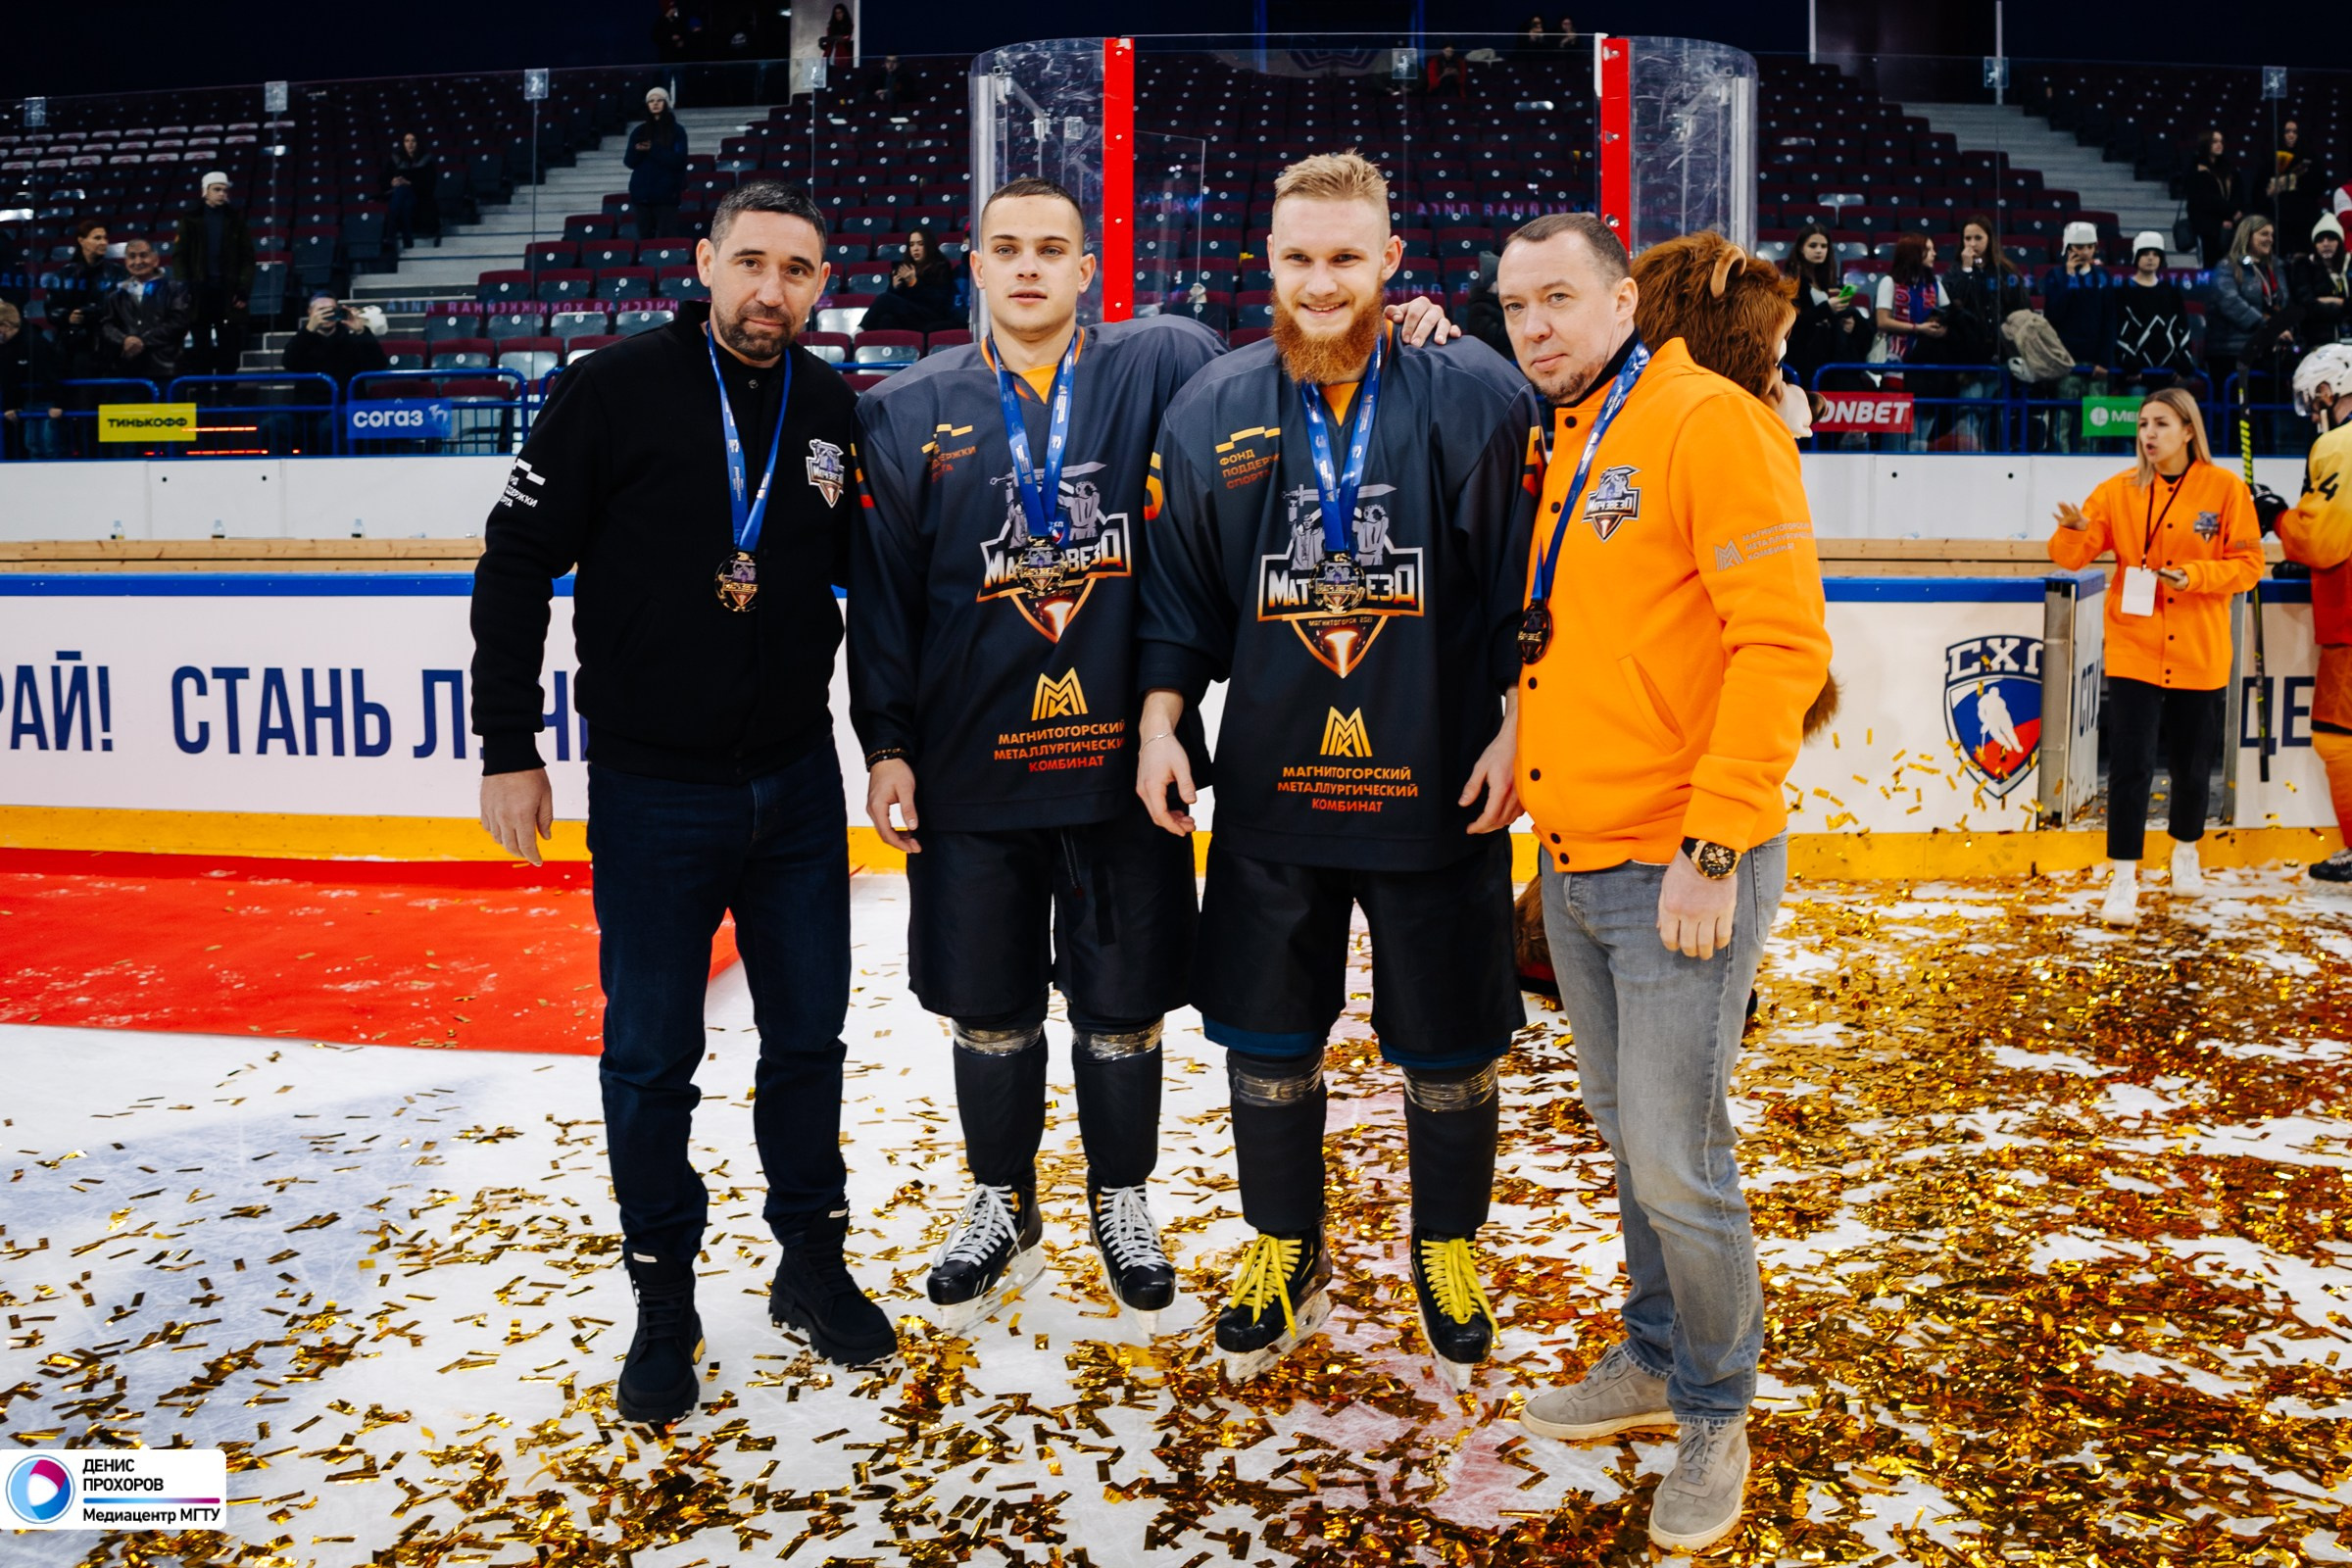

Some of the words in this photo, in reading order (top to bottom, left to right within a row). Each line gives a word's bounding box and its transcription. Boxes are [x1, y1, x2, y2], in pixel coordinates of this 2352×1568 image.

[1819, 400, 1911, 423] ONBET
[1219, 449, 1255, 466] ФОНД
[0, 651, 114, 753] АЙ!
[171, 665, 392, 758] СТАНЬ
[2079, 660, 2099, 738] СТУ
[994, 737, 1125, 760] МЕТАЛЛУРГИЧЕСКИ
[1028, 756, 1104, 772] КОМБИНАТ
[1282, 765, 1411, 780] МАГНИТОГОРСКИЙ
[1277, 782, 1419, 798] МЕТАЛЛУРГИЧЕСКИЙ
[1311, 798, 1384, 812] КОМБИНАТ
